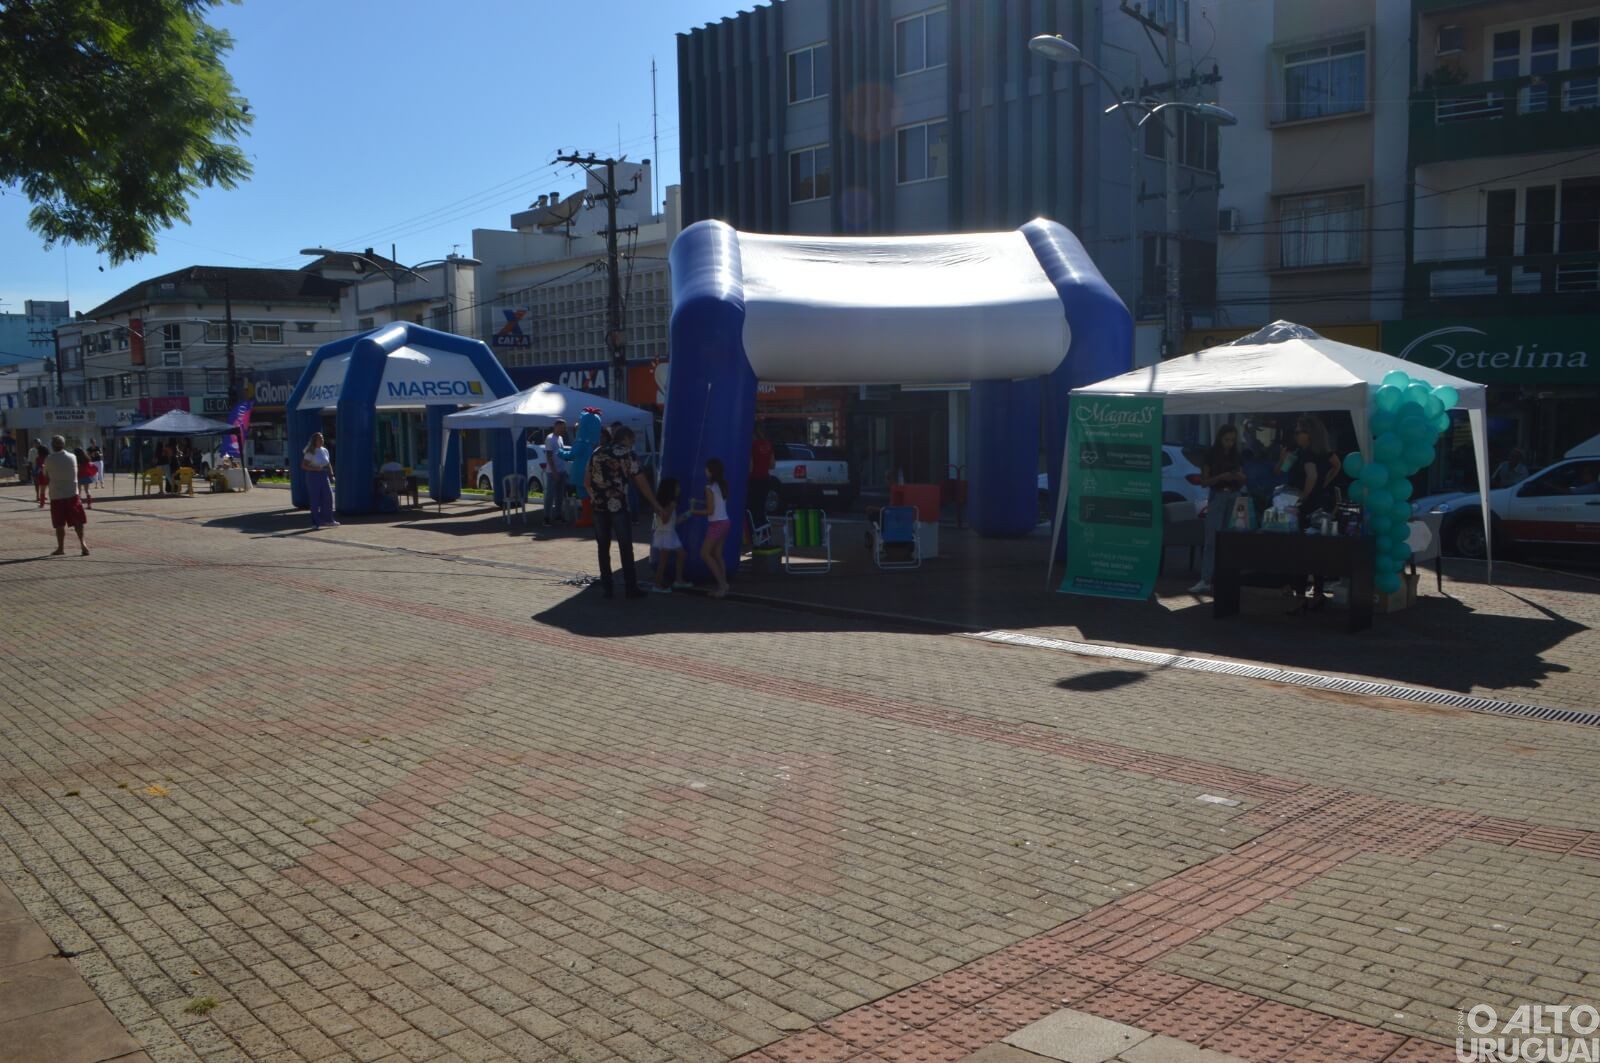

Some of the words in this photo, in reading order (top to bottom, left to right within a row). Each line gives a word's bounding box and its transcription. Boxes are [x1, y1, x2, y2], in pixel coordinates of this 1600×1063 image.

[497, 335, 529, 347] CAIXA
[559, 367, 606, 389] CAIXA
[387, 380, 483, 396] MARSOL
